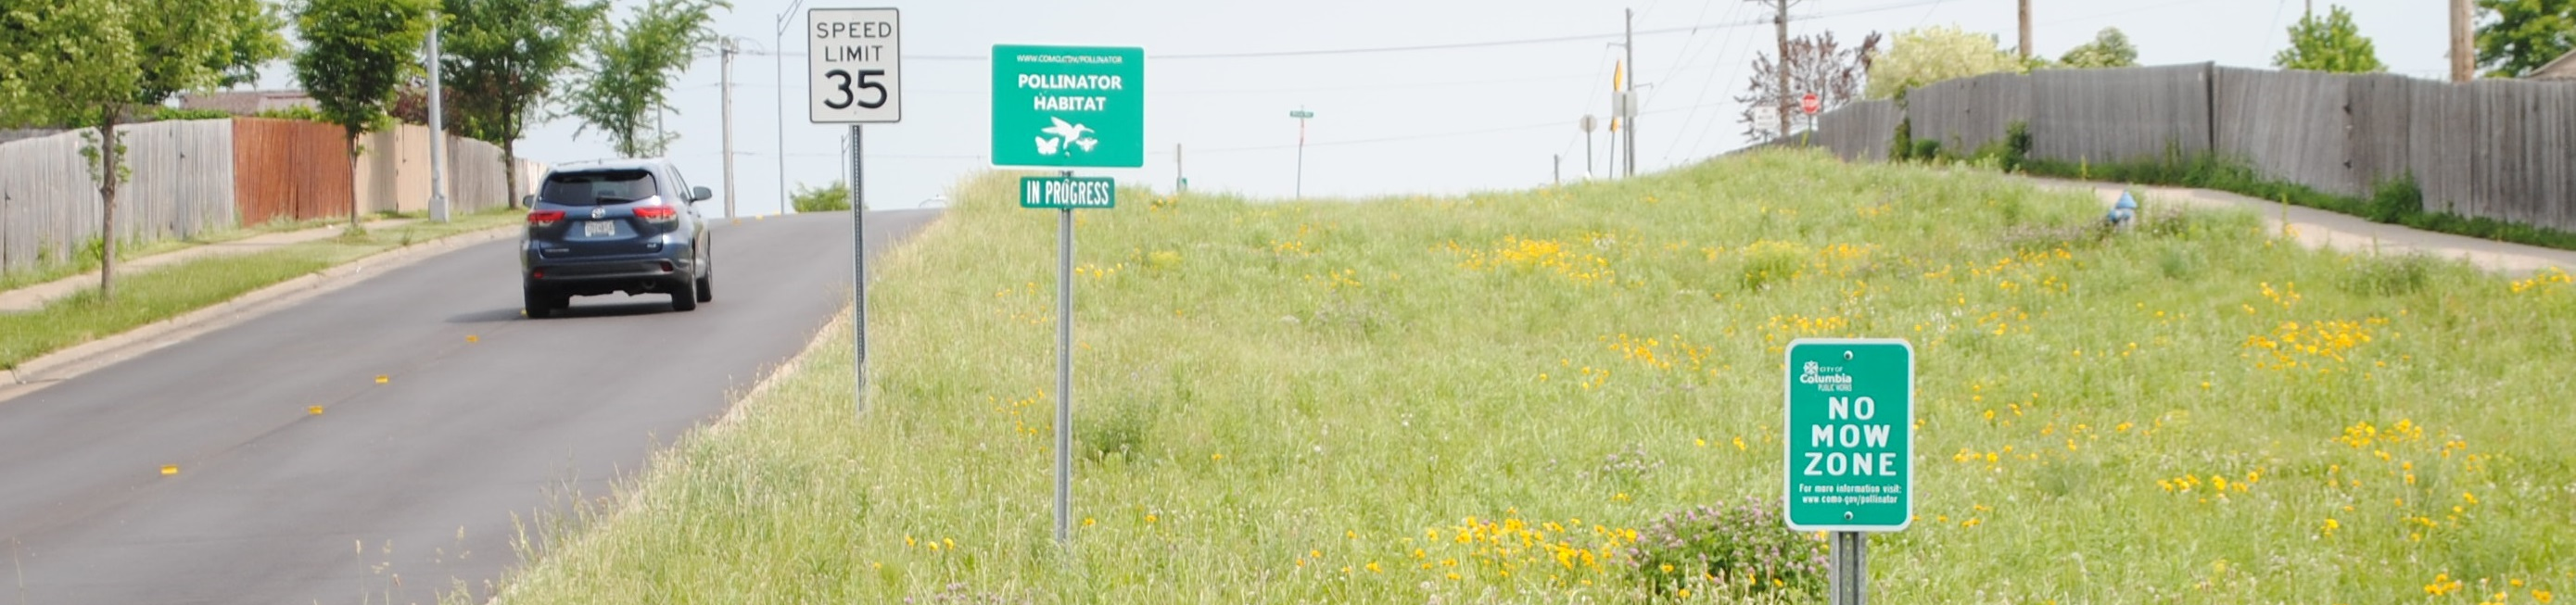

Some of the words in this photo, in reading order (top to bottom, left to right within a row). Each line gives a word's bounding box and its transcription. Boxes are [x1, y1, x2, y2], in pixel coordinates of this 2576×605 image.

[817, 22, 892, 39] SPEED
[825, 45, 883, 62] LIMIT
[823, 69, 888, 109] 35
[1018, 74, 1123, 90] POLLINATOR
[1034, 95, 1107, 111] HABITAT
[1026, 181, 1040, 205] IN
[1045, 181, 1110, 205] PROGRESS
[1799, 373, 1853, 384] Columbia
[1828, 397, 1875, 421] NO
[1811, 424, 1891, 448] MOW
[1803, 452, 1897, 476] ZONE
[1799, 484, 1812, 493] For
[1836, 484, 1881, 493] information
